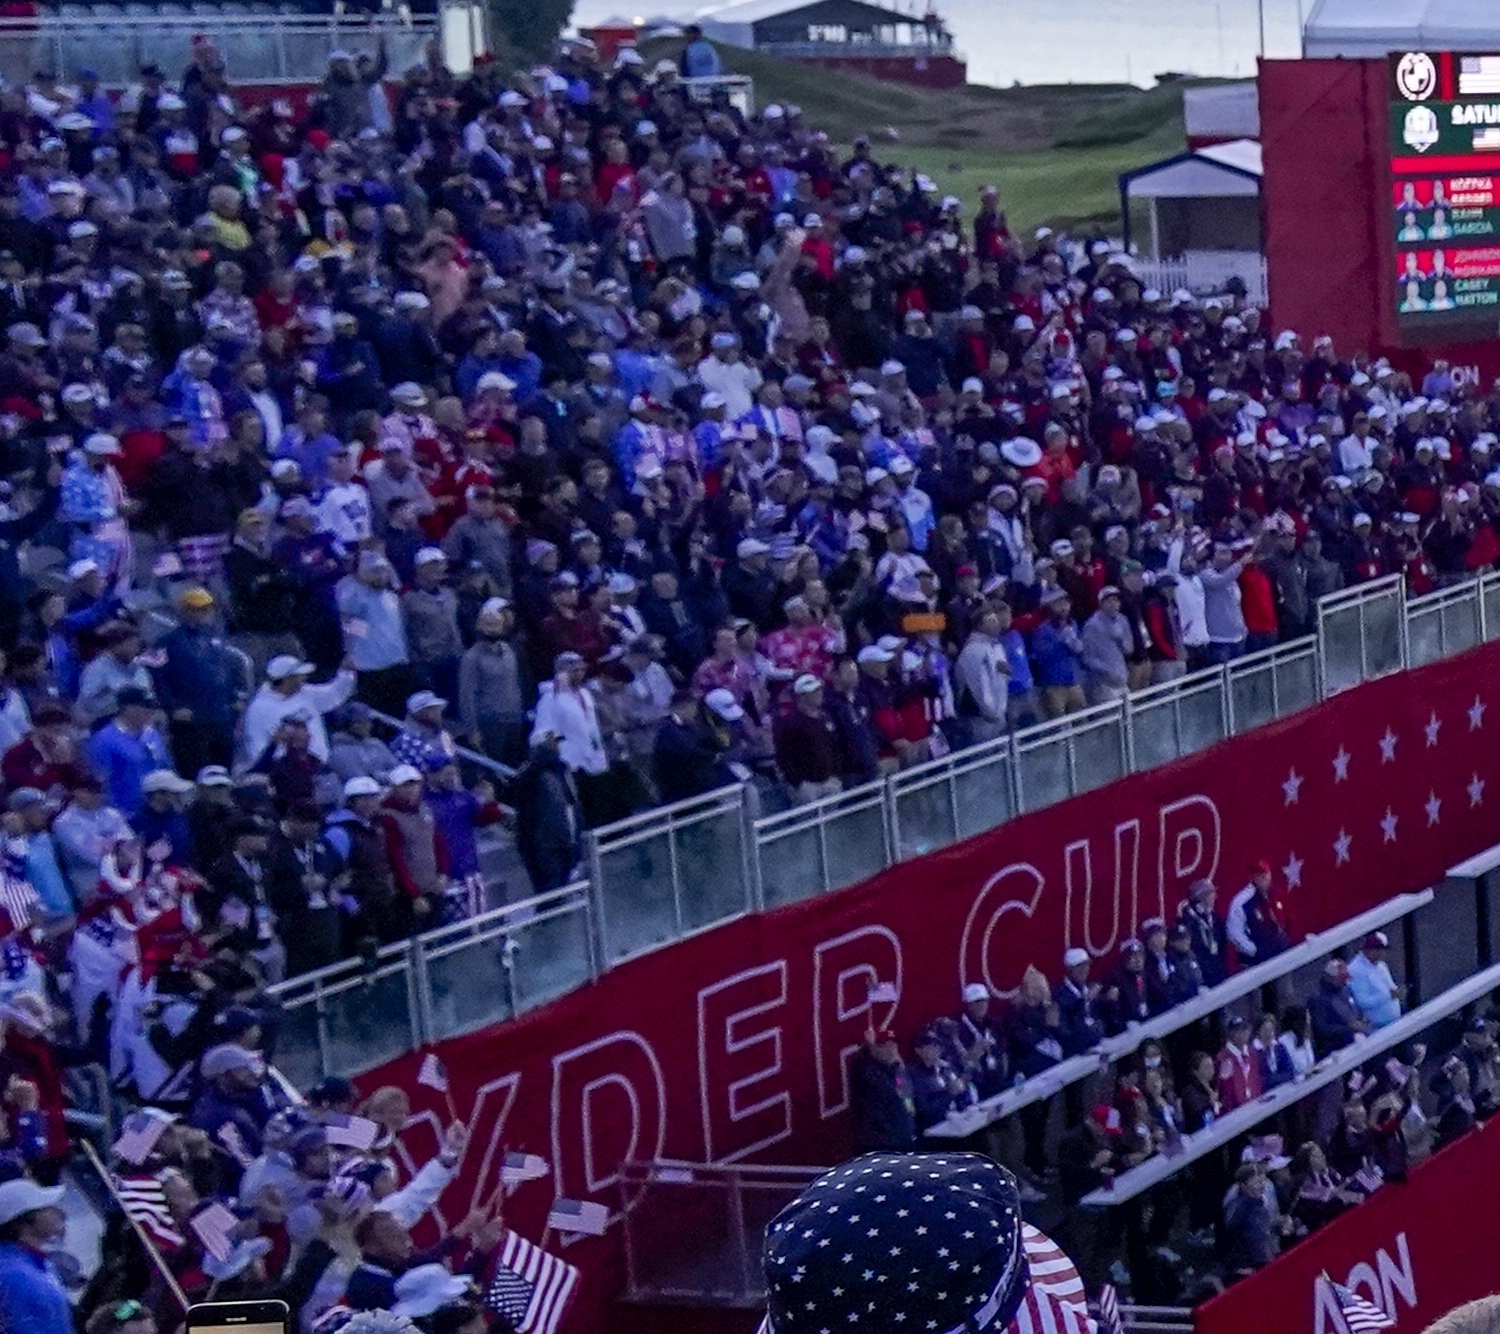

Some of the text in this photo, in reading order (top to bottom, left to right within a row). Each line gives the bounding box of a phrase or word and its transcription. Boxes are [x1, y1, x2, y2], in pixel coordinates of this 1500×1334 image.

[1450, 365, 1479, 386] ON
[392, 794, 1222, 1247] YDER CUP
